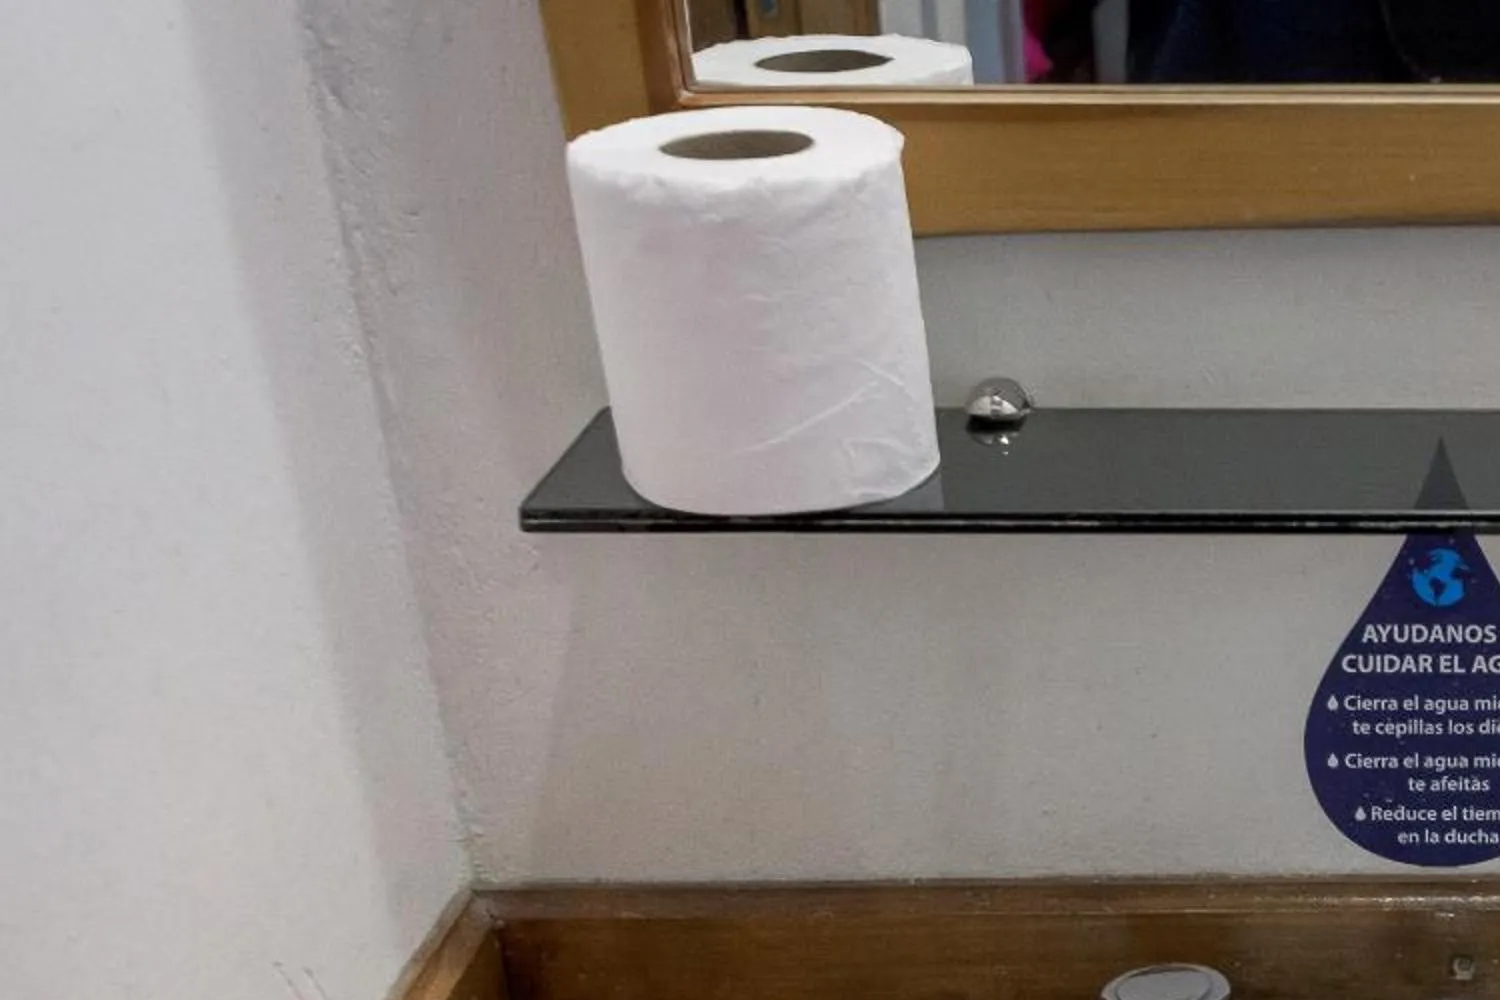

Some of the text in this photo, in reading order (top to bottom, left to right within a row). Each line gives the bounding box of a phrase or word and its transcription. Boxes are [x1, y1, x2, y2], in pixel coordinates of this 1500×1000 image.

[1361, 623, 1497, 644] AYUDANOS
[1341, 653, 1433, 674] CUIDAR
[1439, 654, 1466, 674] EL
[1343, 694, 1399, 711] Cierra
[1402, 694, 1420, 711] el
[1423, 698, 1469, 716] agua
[1352, 719, 1371, 735] te
[1374, 718, 1444, 738] cepillas
[1447, 718, 1475, 735] los
[1344, 753, 1399, 768] Cierra
[1402, 752, 1420, 768] el
[1423, 756, 1469, 773] agua
[1407, 777, 1427, 792] te
[1371, 805, 1438, 821] Reduce
[1441, 805, 1458, 821] el
[1397, 828, 1500, 844] en la ducha
